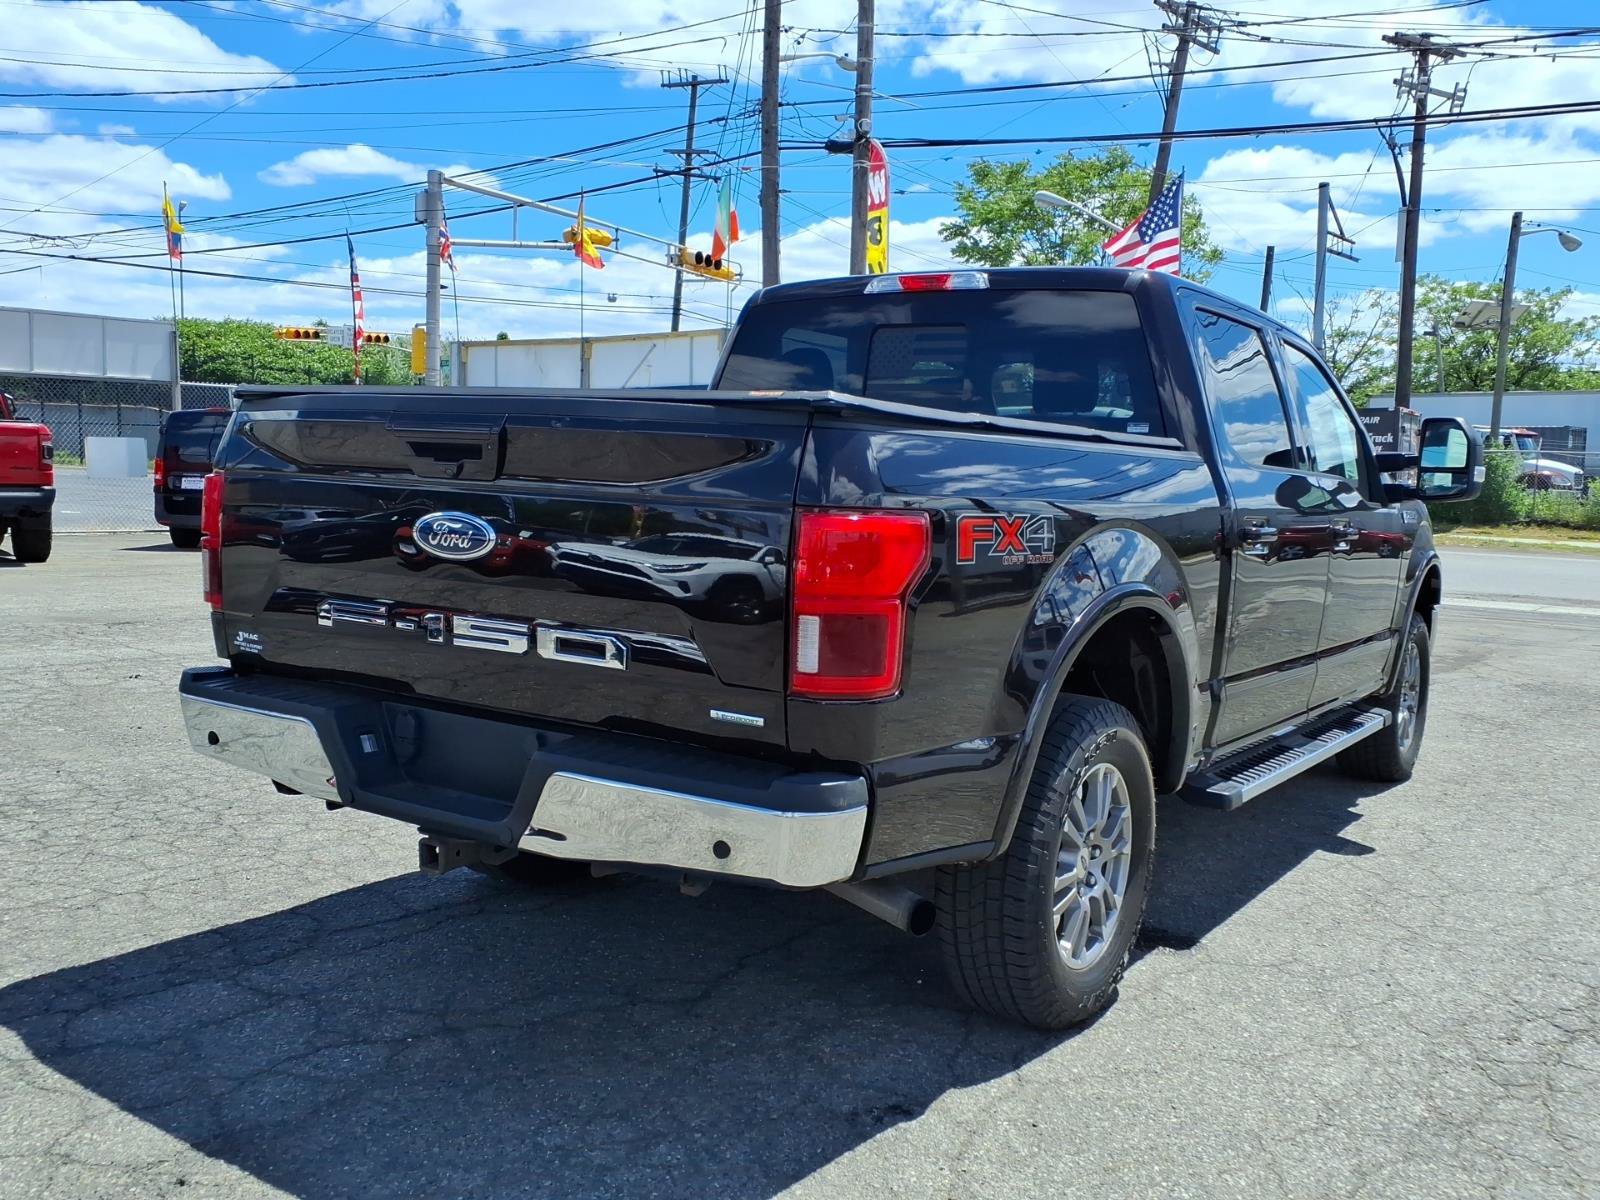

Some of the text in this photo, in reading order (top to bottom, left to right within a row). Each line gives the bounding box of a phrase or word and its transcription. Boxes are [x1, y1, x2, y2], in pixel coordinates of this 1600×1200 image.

[429, 521, 473, 548] Ford
[956, 513, 1056, 565] FX4
[317, 599, 629, 671] F-150
